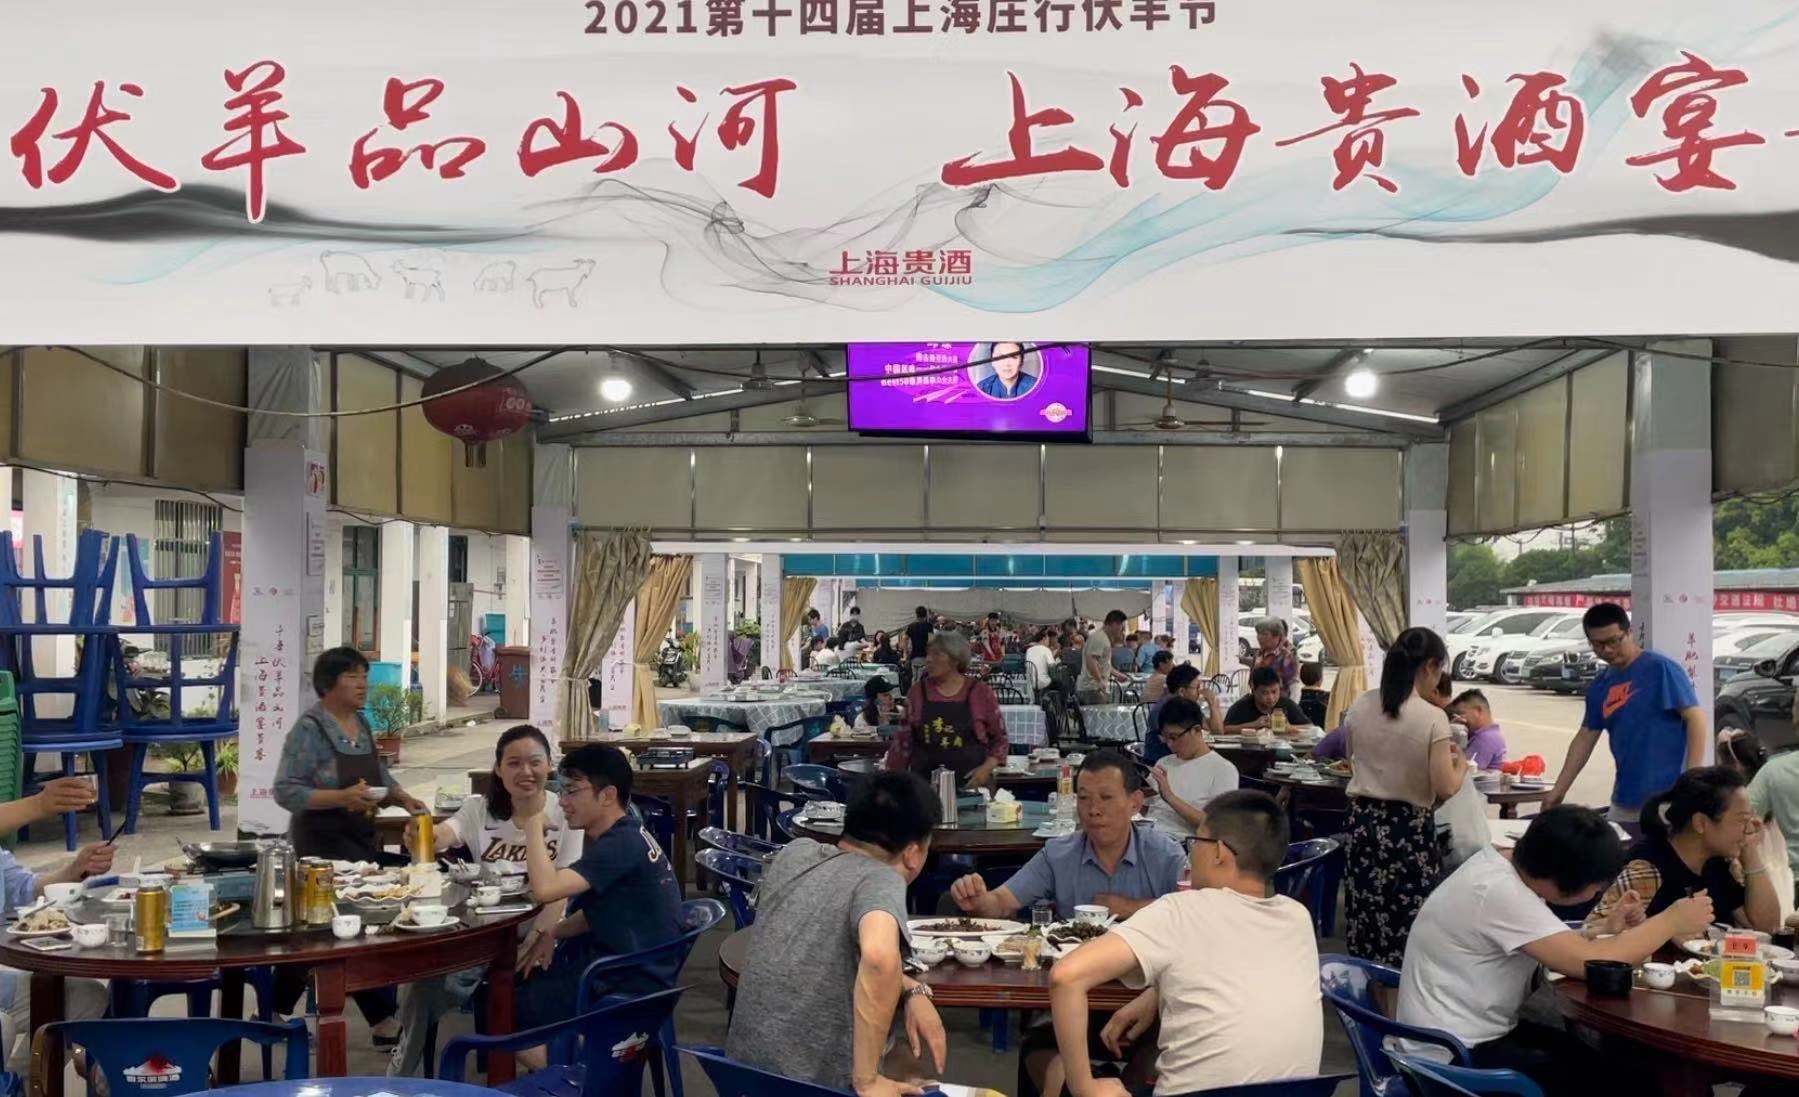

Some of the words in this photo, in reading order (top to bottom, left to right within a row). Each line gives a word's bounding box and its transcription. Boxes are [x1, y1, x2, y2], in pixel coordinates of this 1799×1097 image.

[584, 0, 1216, 36] 2021第十四届上海庄行伏羊节
[11, 61, 796, 222] 伏羊品山河
[942, 50, 1799, 193] 上海贵酒宴
[829, 250, 972, 275] 上海贵酒
[829, 275, 915, 286] SHANGHAI
[920, 275, 972, 286] GUIJIU
[481, 836, 558, 863] LAKS
